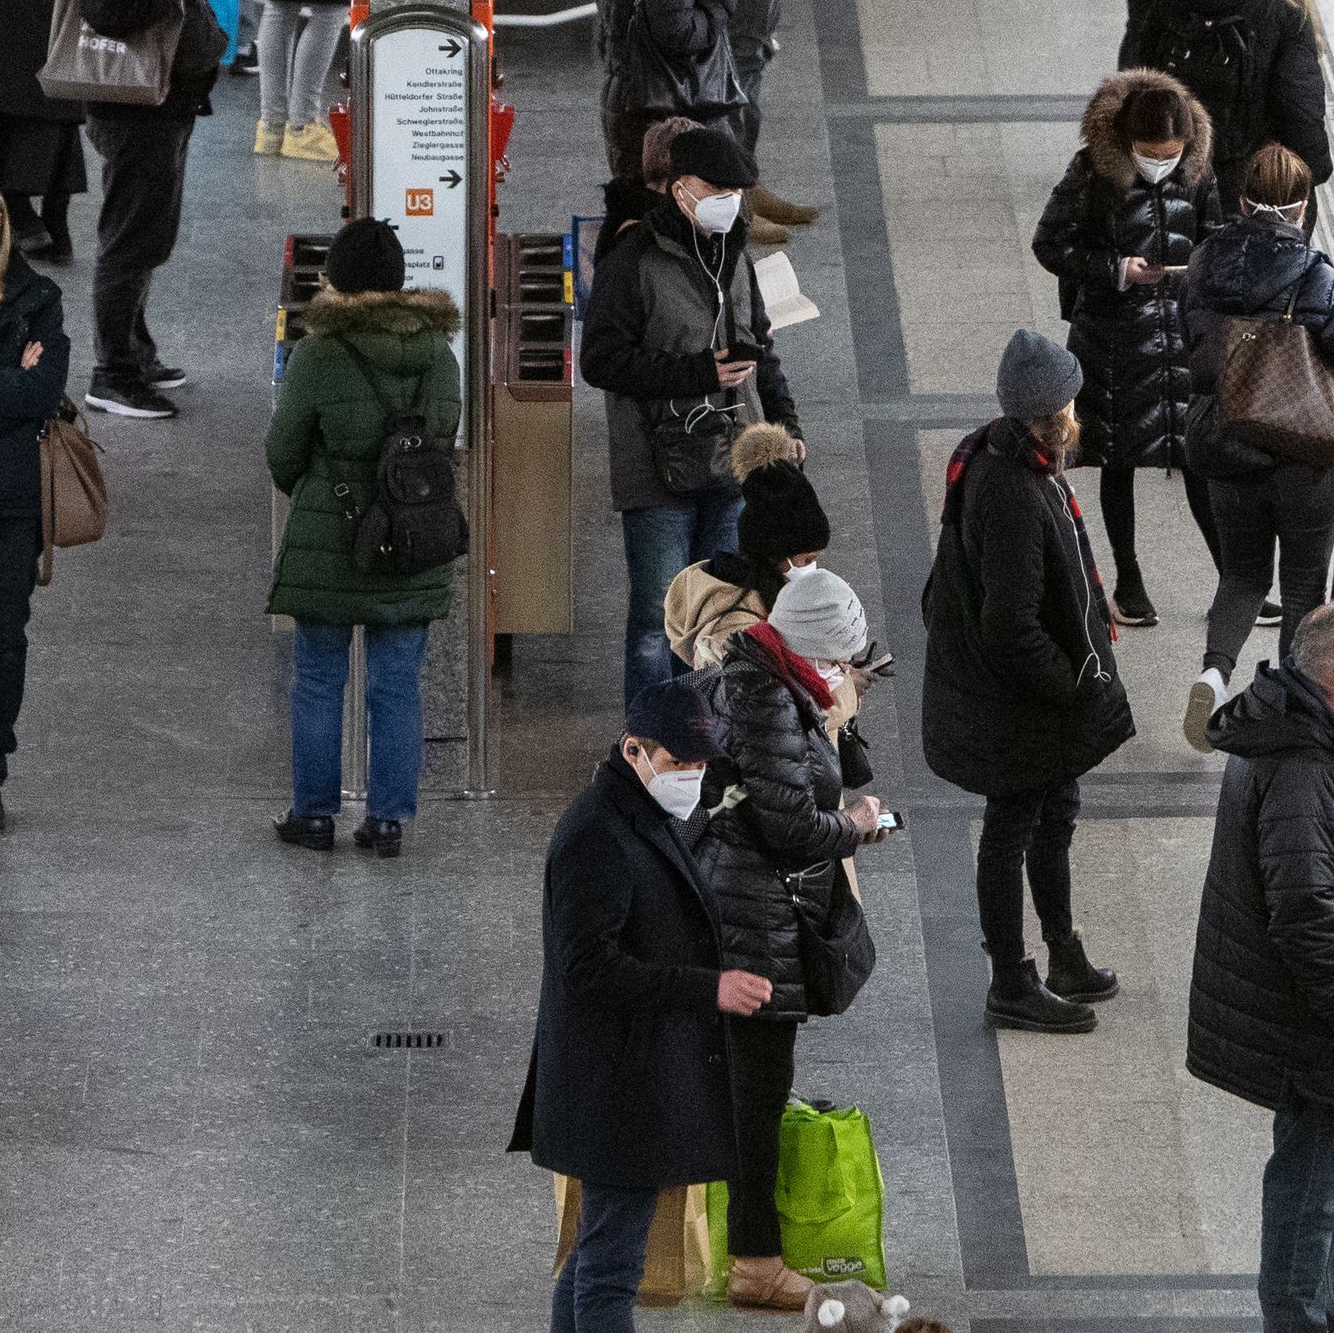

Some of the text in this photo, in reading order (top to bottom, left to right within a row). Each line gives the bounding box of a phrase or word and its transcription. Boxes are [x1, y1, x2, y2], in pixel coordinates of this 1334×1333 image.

[425, 67, 463, 76] Ottakring
[419, 105, 463, 113] Johnstraße
[396, 117, 464, 126] Schweglerstraße
[411, 154, 464, 162] Neubaugasse
[407, 195, 432, 210] U3
